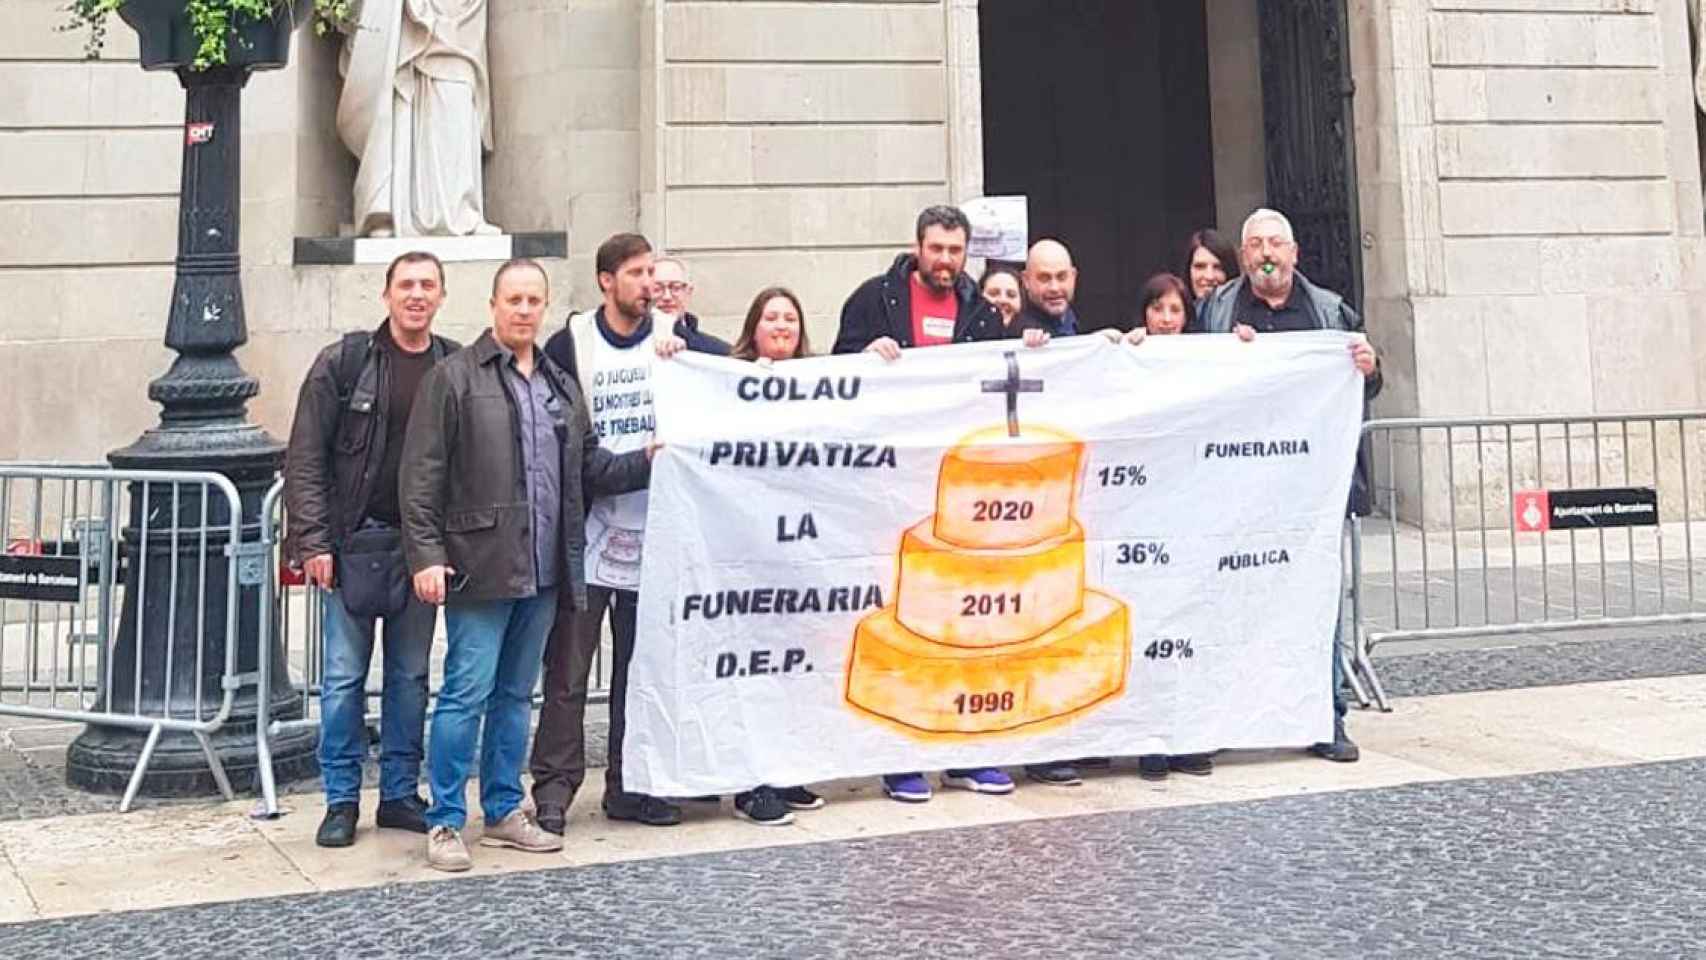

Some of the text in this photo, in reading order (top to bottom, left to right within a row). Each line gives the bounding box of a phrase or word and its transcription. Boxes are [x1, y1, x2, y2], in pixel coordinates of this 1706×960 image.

[737, 376, 862, 402] COLAU
[709, 440, 897, 469] PRIVATIZA
[1204, 439, 1310, 459] FUNERARIA
[1098, 464, 1148, 488] 15%
[972, 501, 1035, 522] 2020
[776, 513, 818, 542] LA
[1115, 542, 1170, 565] 36%
[682, 584, 884, 622] FUNERARIA
[960, 592, 1023, 617] 2011
[1143, 637, 1195, 661] 49%
[715, 648, 814, 680] D.E.P.
[953, 690, 1016, 715] 1998
